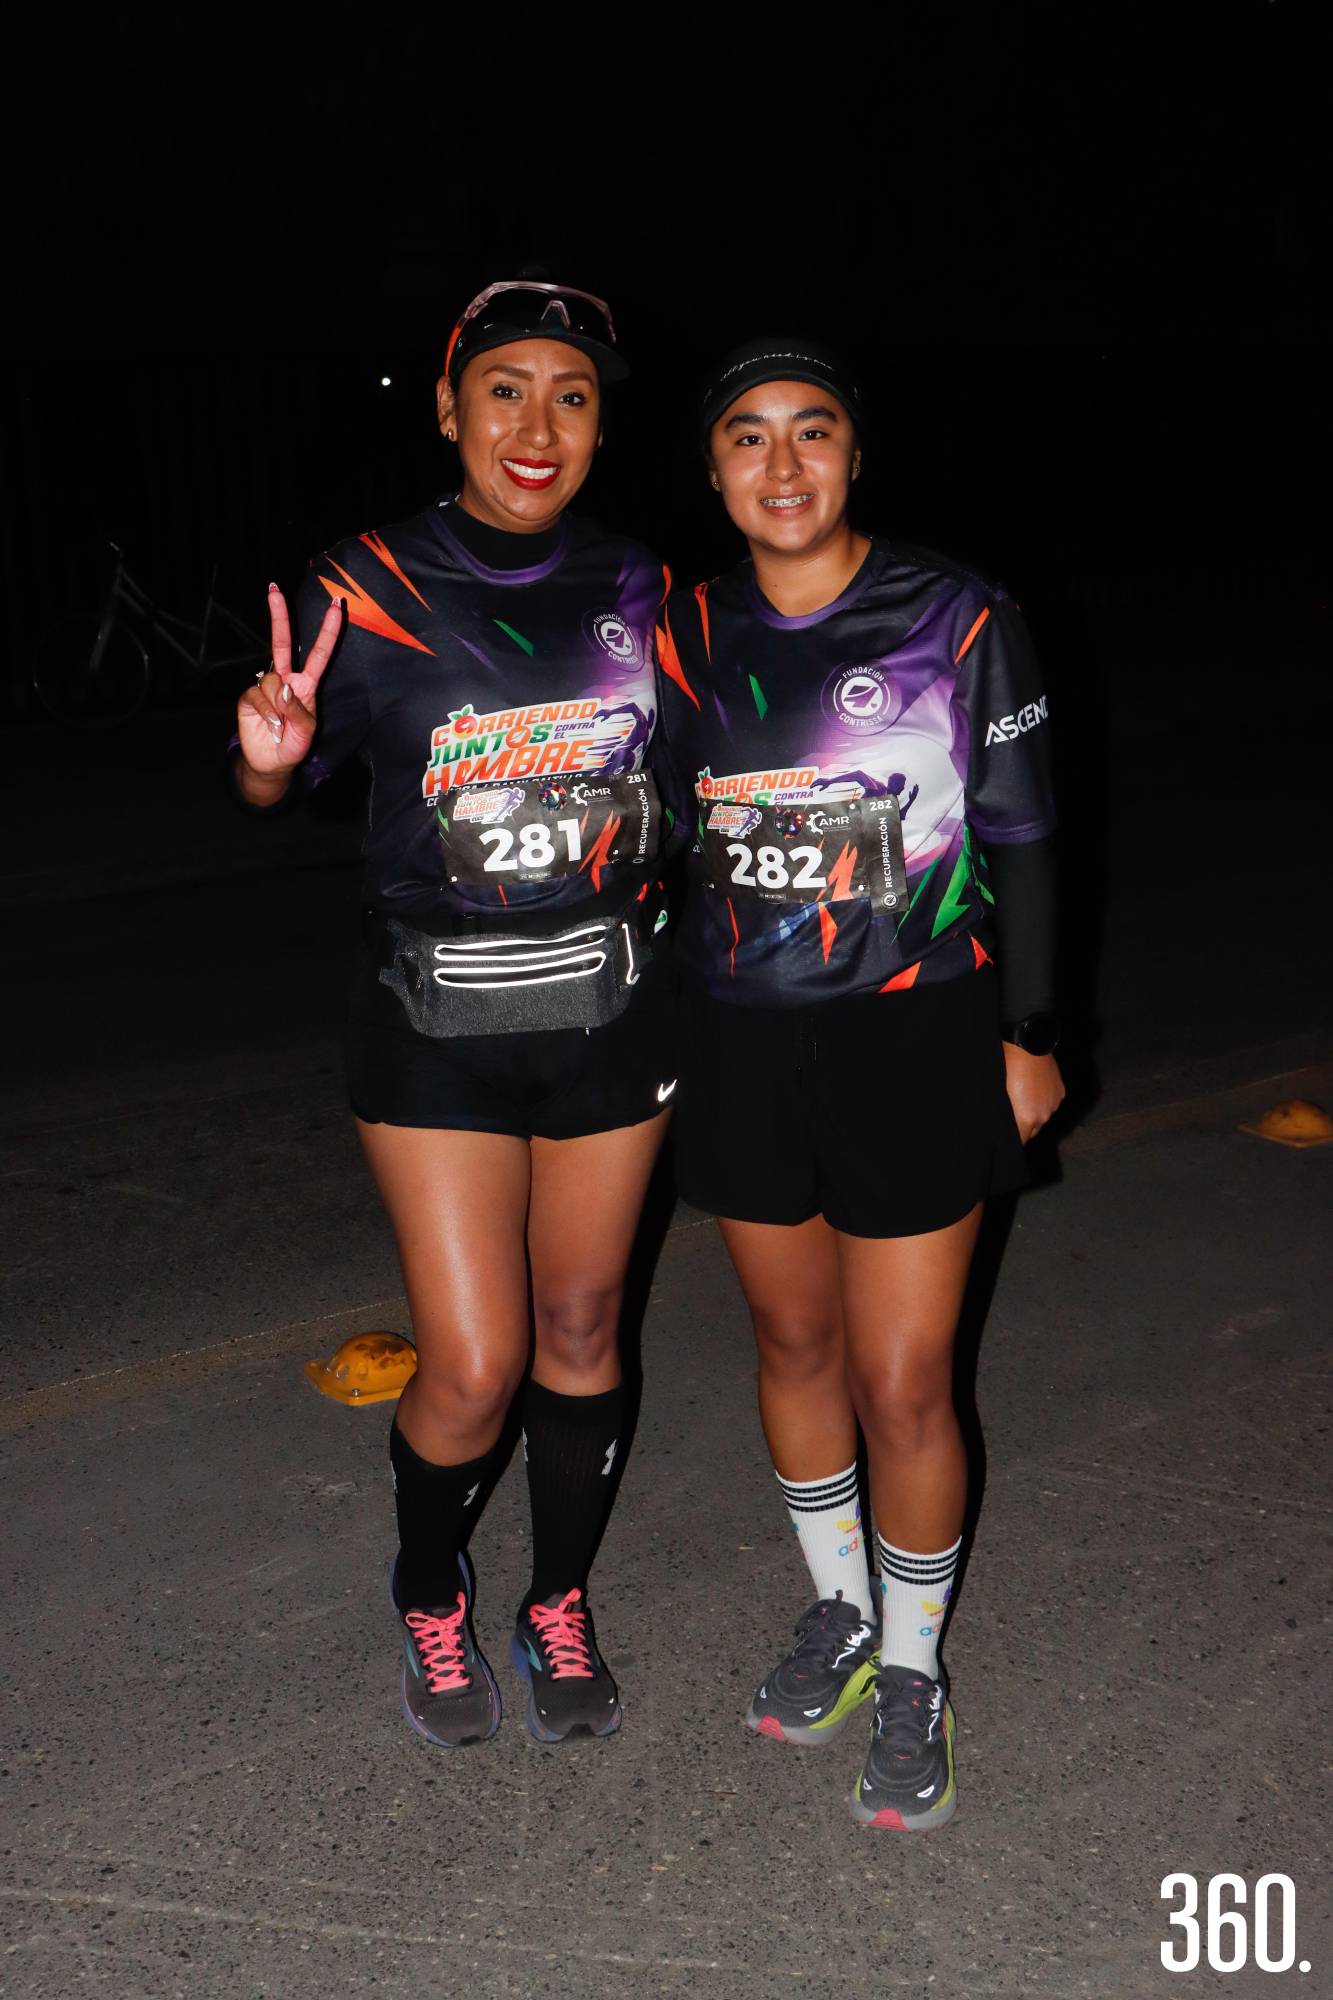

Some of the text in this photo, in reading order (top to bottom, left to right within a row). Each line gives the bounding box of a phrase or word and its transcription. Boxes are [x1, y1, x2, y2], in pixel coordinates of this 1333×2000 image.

[433, 701, 599, 747] CORRIENDO
[554, 731, 566, 740] EL
[555, 721, 596, 732] CONTRA
[429, 723, 554, 768] JUNTOS
[425, 739, 596, 798] HAMBRE
[626, 773, 648, 784] 281
[583, 787, 612, 798] AMR
[774, 790, 814, 801] CONTRA
[869, 799, 893, 812] 282
[638, 788, 650, 855] RECUPERACIÓN
[819, 816, 850, 827] AMR
[478, 818, 582, 872] 281
[878, 817, 893, 888] RECUPERACIÓN
[726, 843, 827, 889] 282
